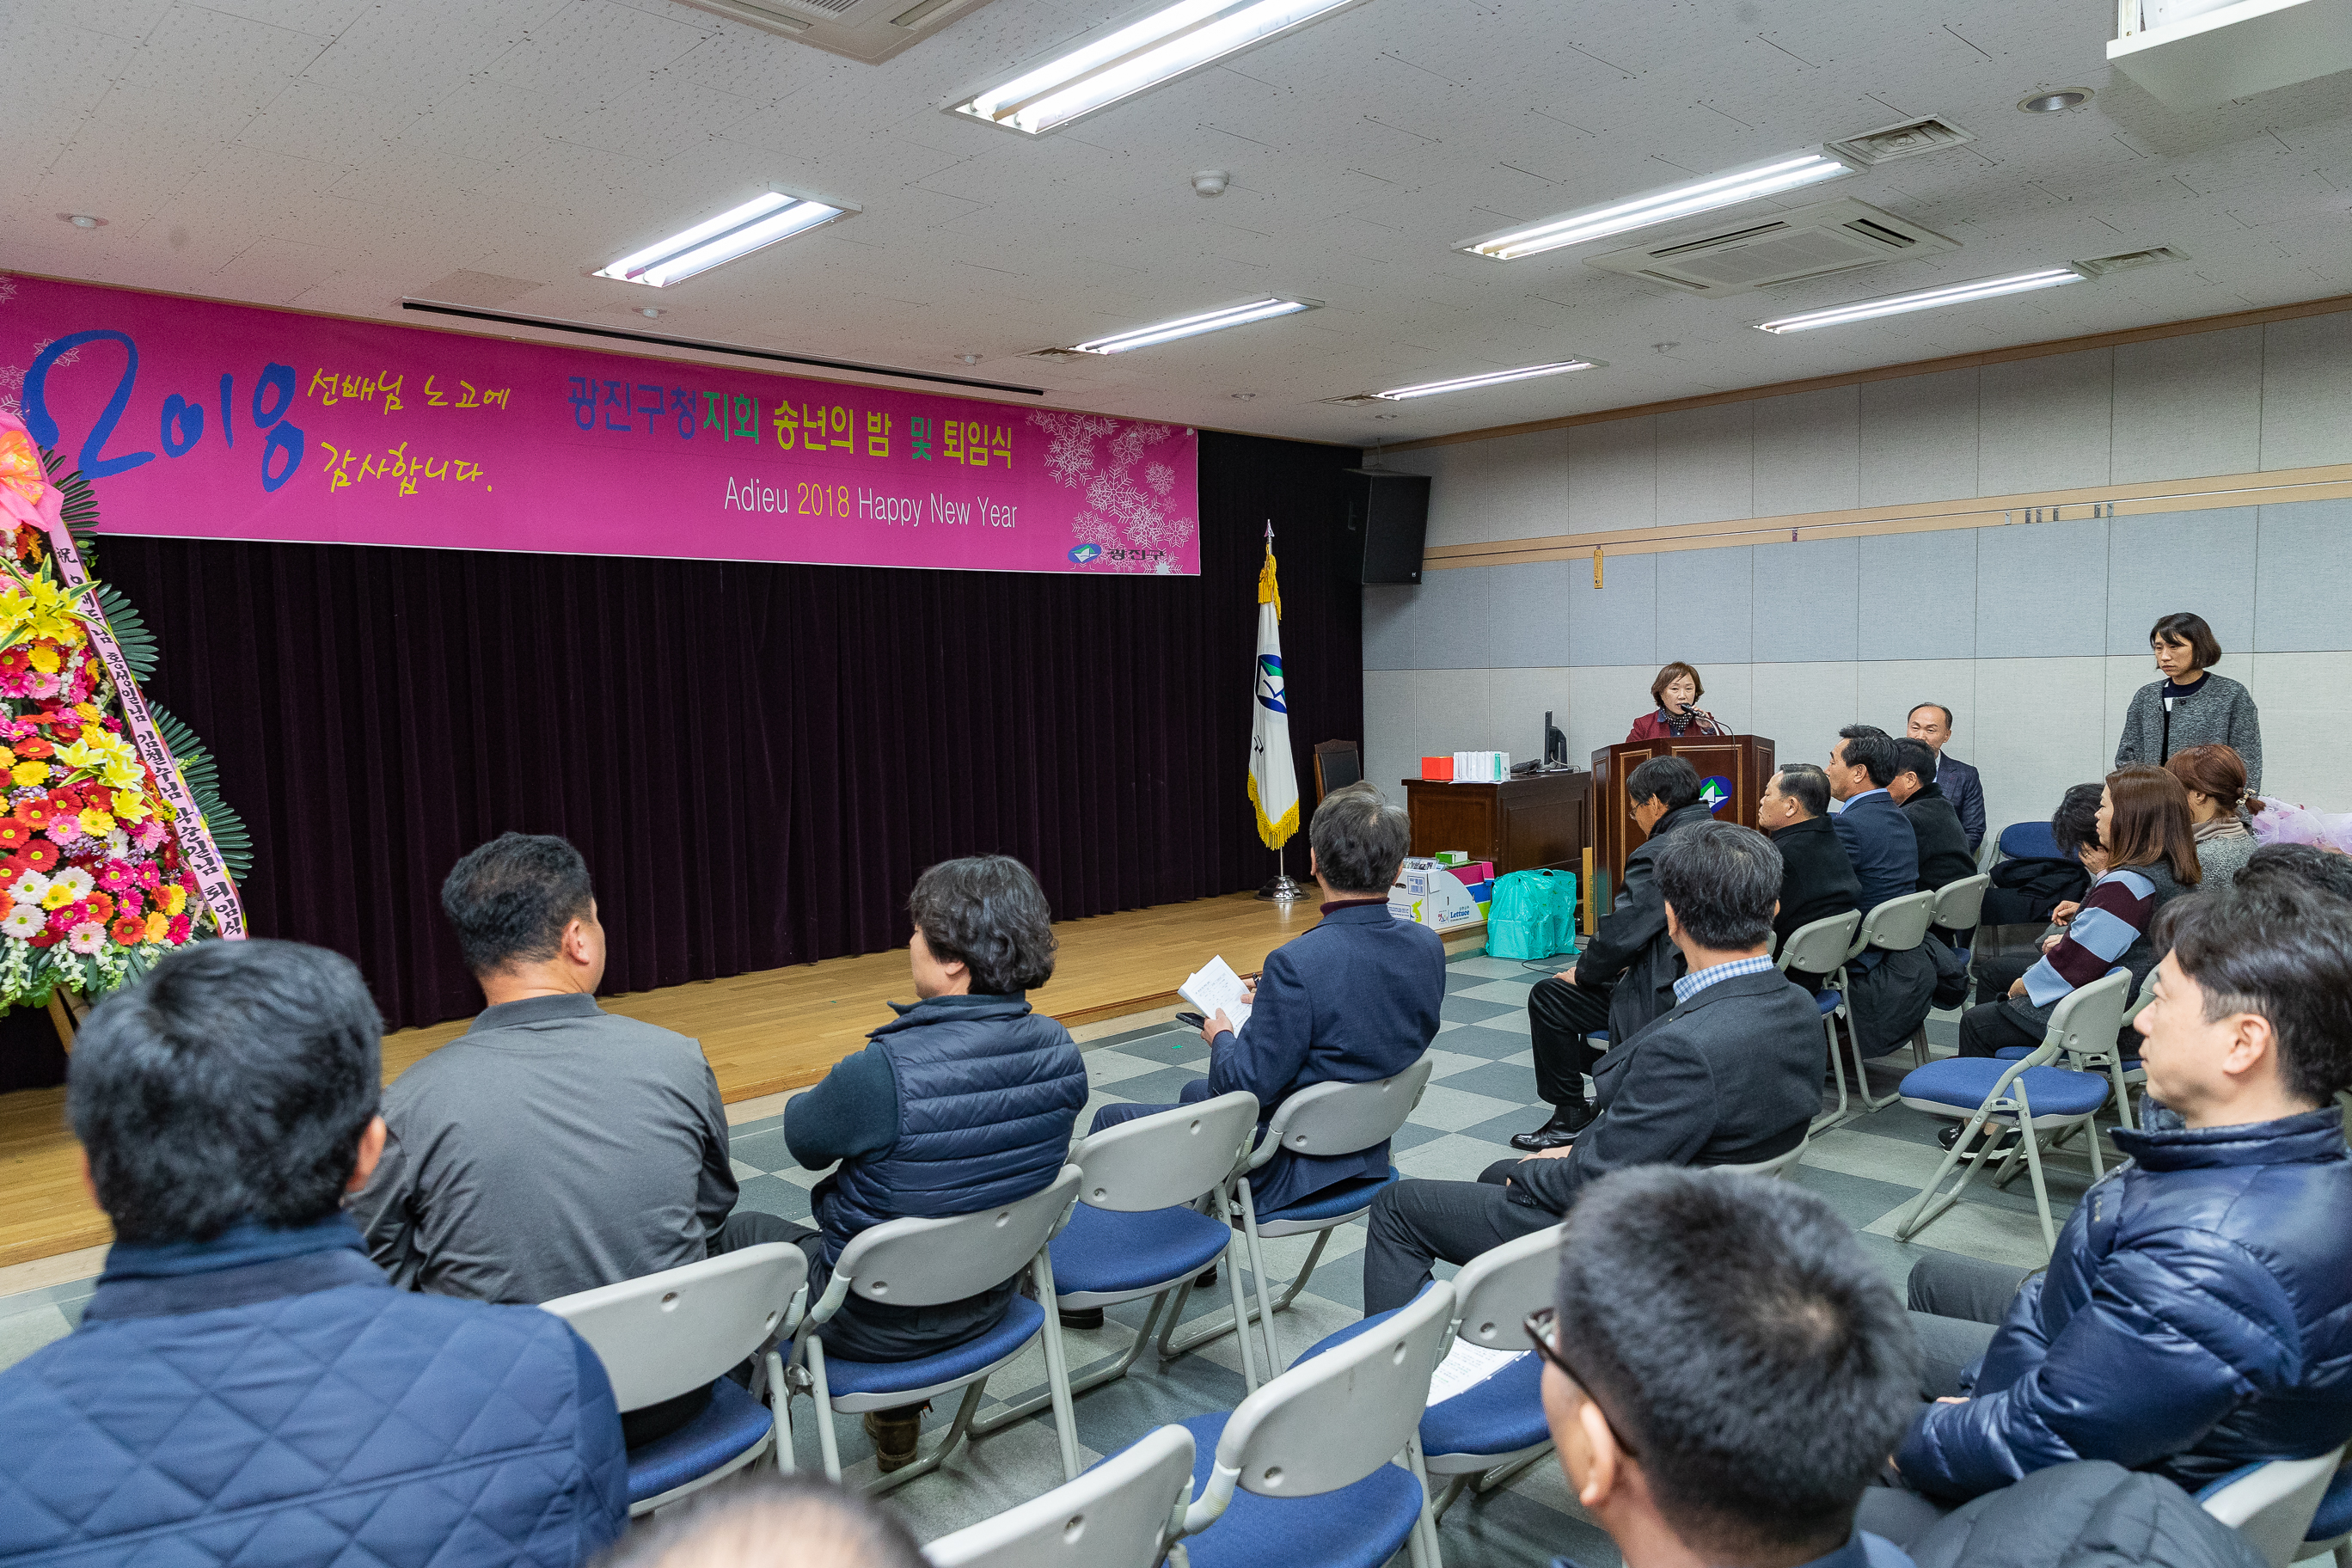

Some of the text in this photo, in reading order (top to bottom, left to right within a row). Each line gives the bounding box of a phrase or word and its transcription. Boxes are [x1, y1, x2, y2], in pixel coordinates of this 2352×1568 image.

[21, 329, 304, 493] 2018
[308, 368, 403, 414] 선배님
[774, 400, 854, 454] 송년의
[867, 411, 891, 457] 밤
[911, 416, 932, 461] 및
[943, 420, 1012, 469] 퇴임식
[321, 441, 492, 498] 감사합니다.
[725, 476, 1017, 529] Adieu 2018 Happy New Year
[1107, 548, 1165, 560] 광진구
[204, 881, 242, 935] 퇴임식
